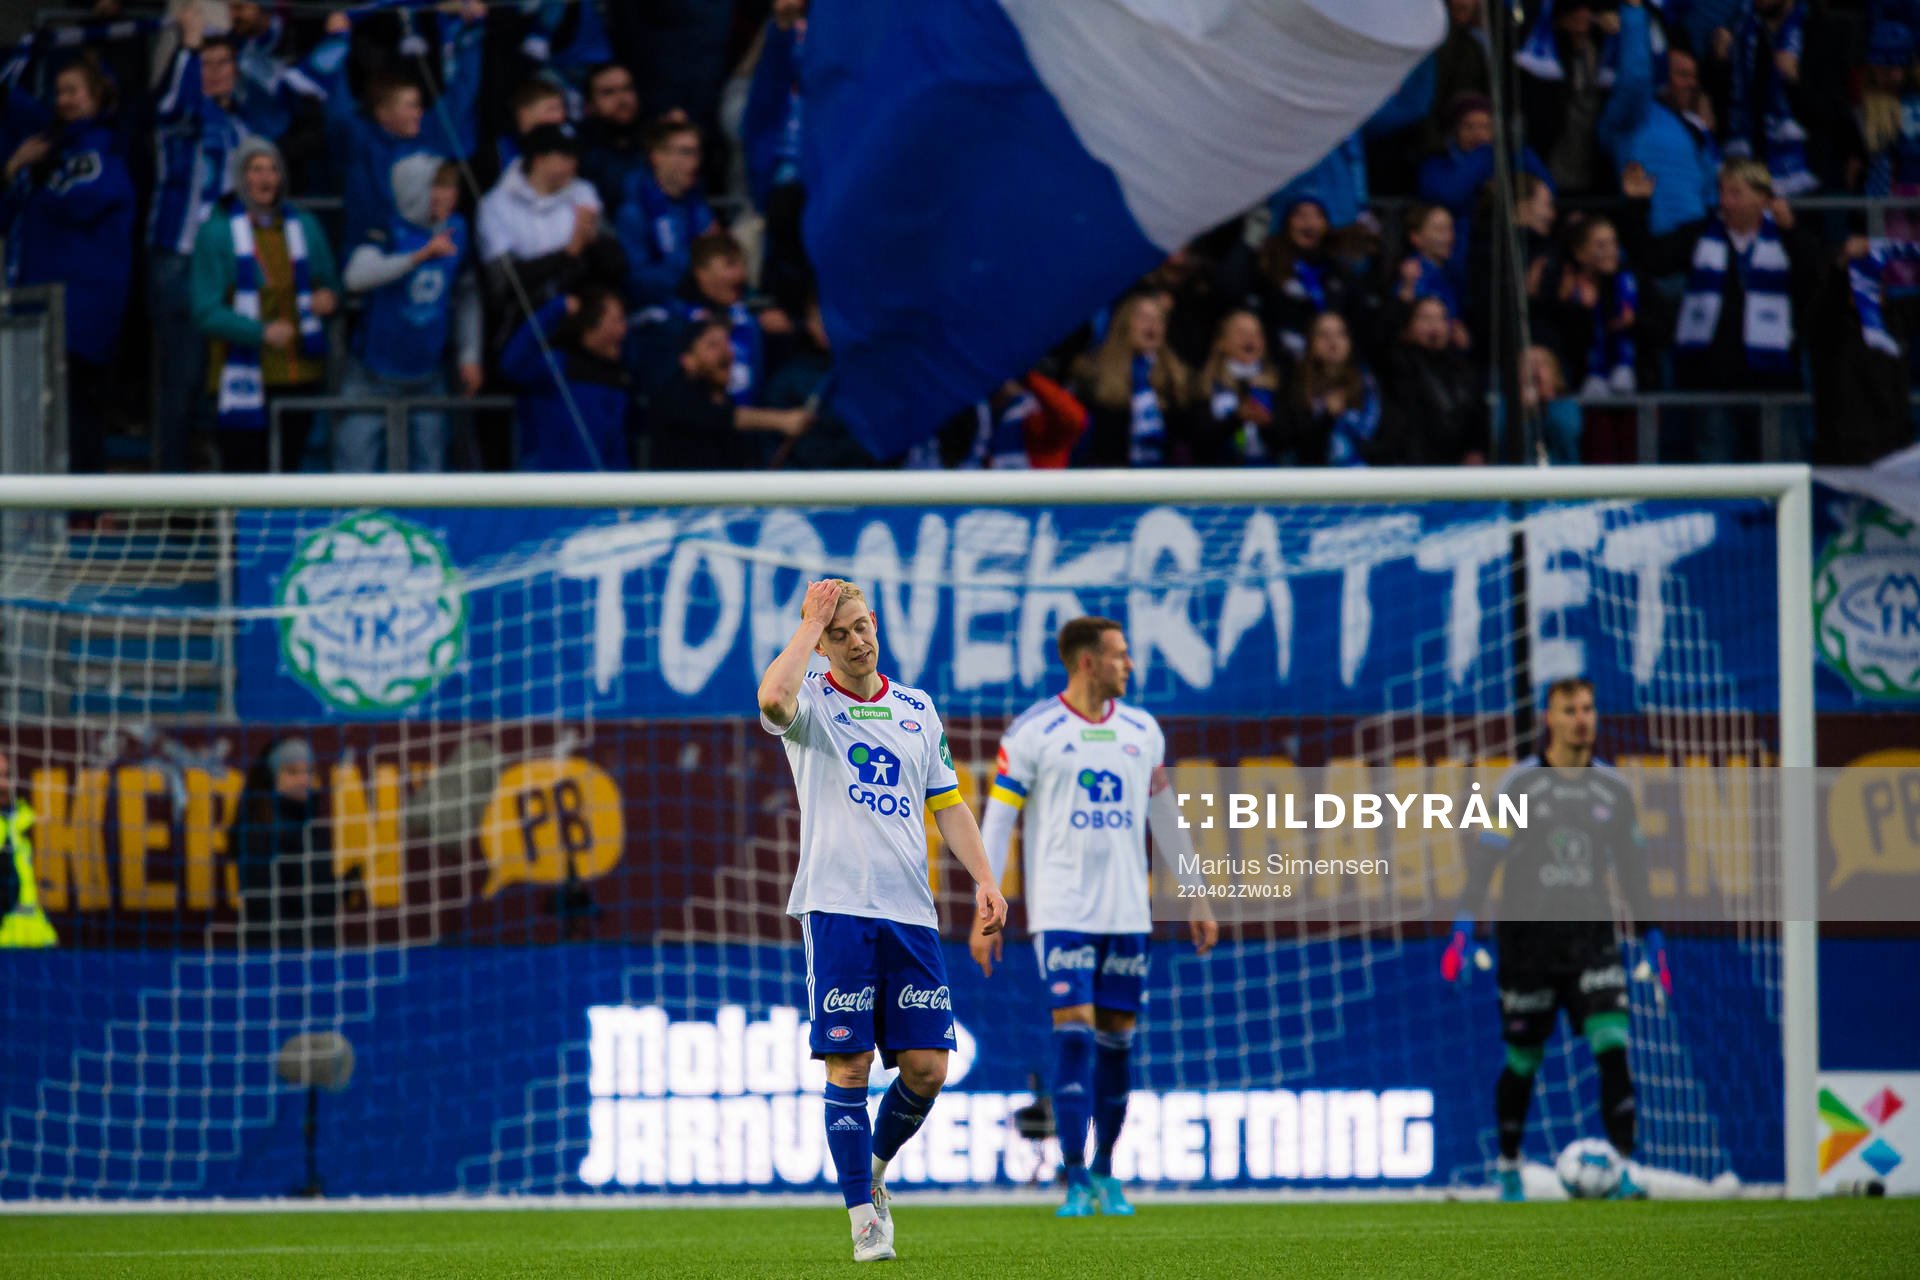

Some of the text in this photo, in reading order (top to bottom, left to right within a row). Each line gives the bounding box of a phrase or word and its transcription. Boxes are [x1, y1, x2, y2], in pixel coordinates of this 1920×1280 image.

[893, 690, 925, 711] coop
[514, 779, 592, 865] PB
[1070, 809, 1133, 829] OBOS
[587, 1004, 850, 1096] Mold
